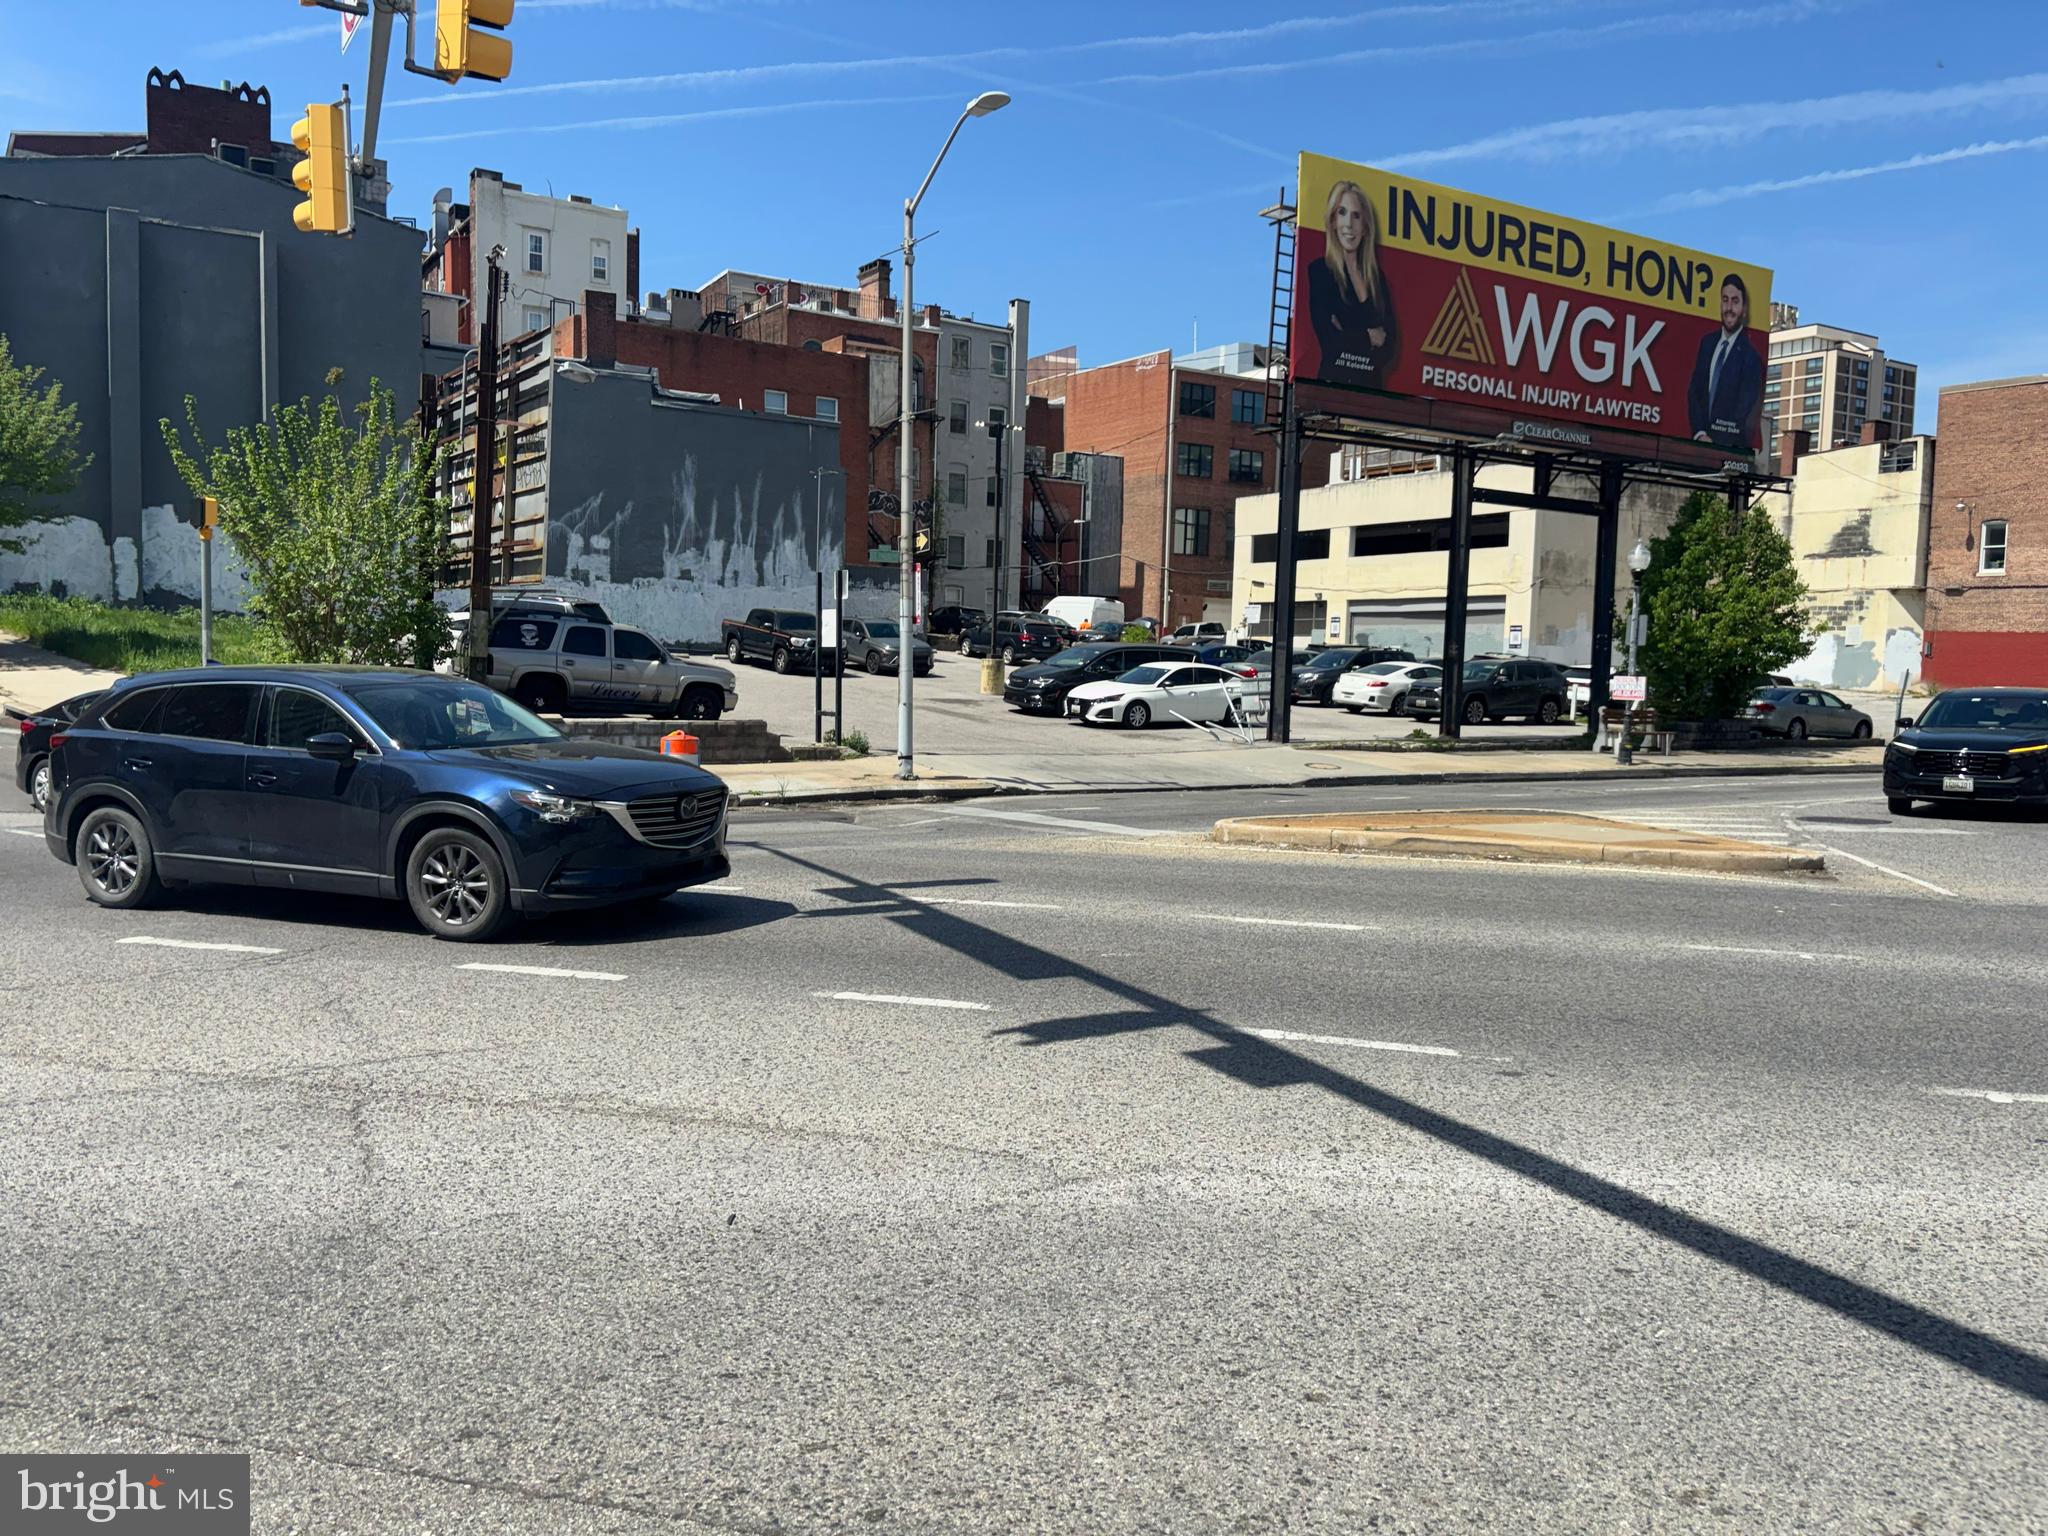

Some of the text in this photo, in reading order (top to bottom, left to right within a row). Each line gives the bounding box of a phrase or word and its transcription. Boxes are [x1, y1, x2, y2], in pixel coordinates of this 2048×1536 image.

[1388, 185, 1714, 308] INJURED, HON?
[1340, 351, 1371, 364] Attorney
[1493, 284, 1667, 393] WGK
[1421, 364, 1662, 425] PERSONAL INJURY LAWYERS
